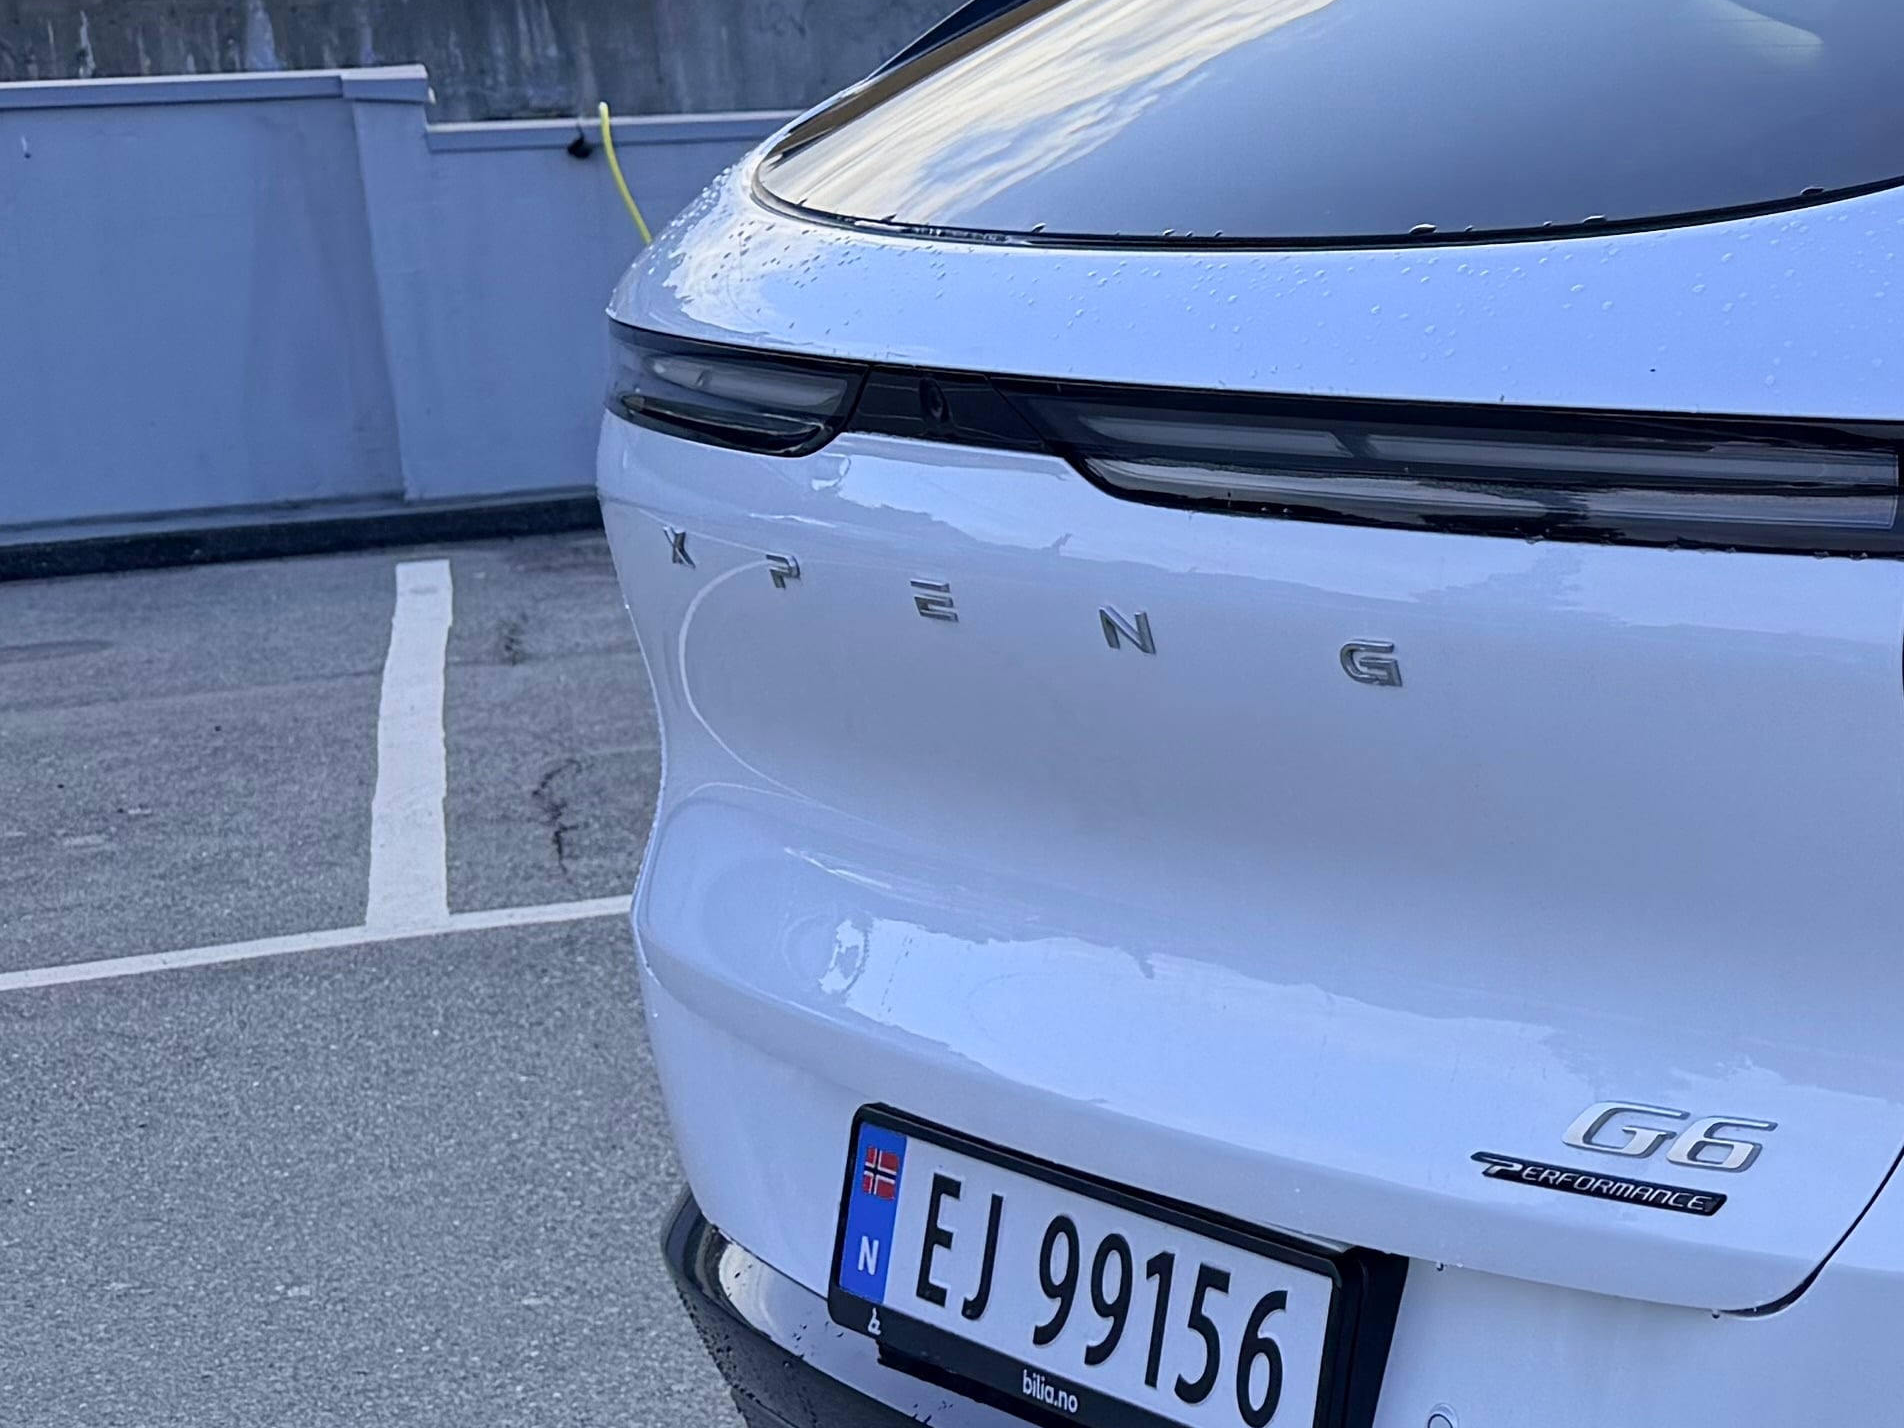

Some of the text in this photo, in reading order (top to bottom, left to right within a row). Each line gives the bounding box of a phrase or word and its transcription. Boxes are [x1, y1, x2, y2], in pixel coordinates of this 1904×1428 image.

[1561, 1099, 1778, 1173] G6
[1474, 1154, 1711, 1212] PERFORMANCE
[857, 1234, 879, 1276] N
[915, 1173, 1288, 1428] EJ 99156
[1023, 1369, 1078, 1413] bilia.no
